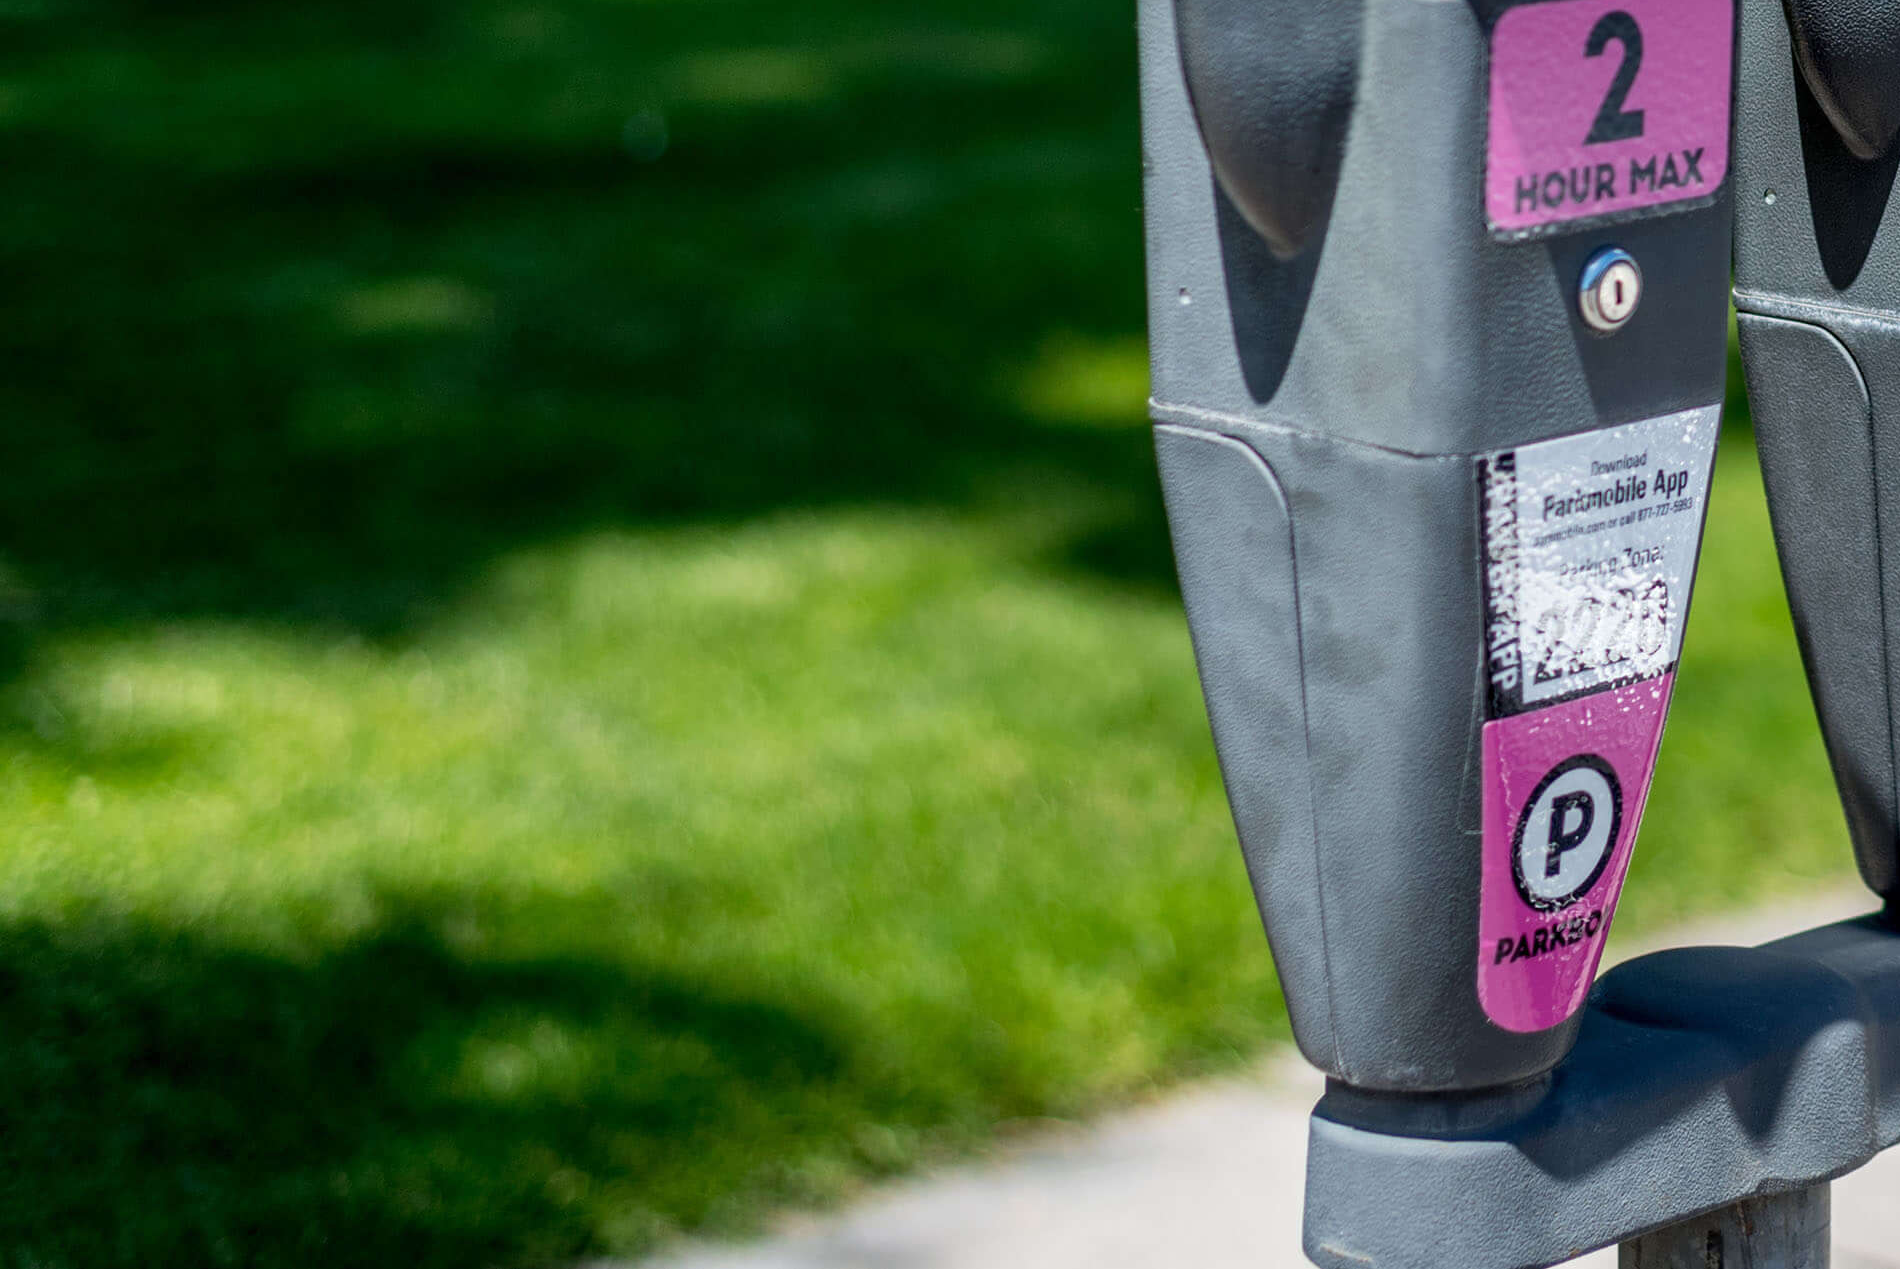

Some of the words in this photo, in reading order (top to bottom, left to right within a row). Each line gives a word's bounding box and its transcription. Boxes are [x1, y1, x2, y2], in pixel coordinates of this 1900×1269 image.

[1582, 10, 1645, 146] 2
[1514, 162, 1616, 215] HOUR
[1630, 147, 1705, 194] MAX
[1591, 448, 1647, 476] Download
[1653, 469, 1689, 500] App
[1490, 621, 1521, 690] APP
[1544, 790, 1595, 879] P
